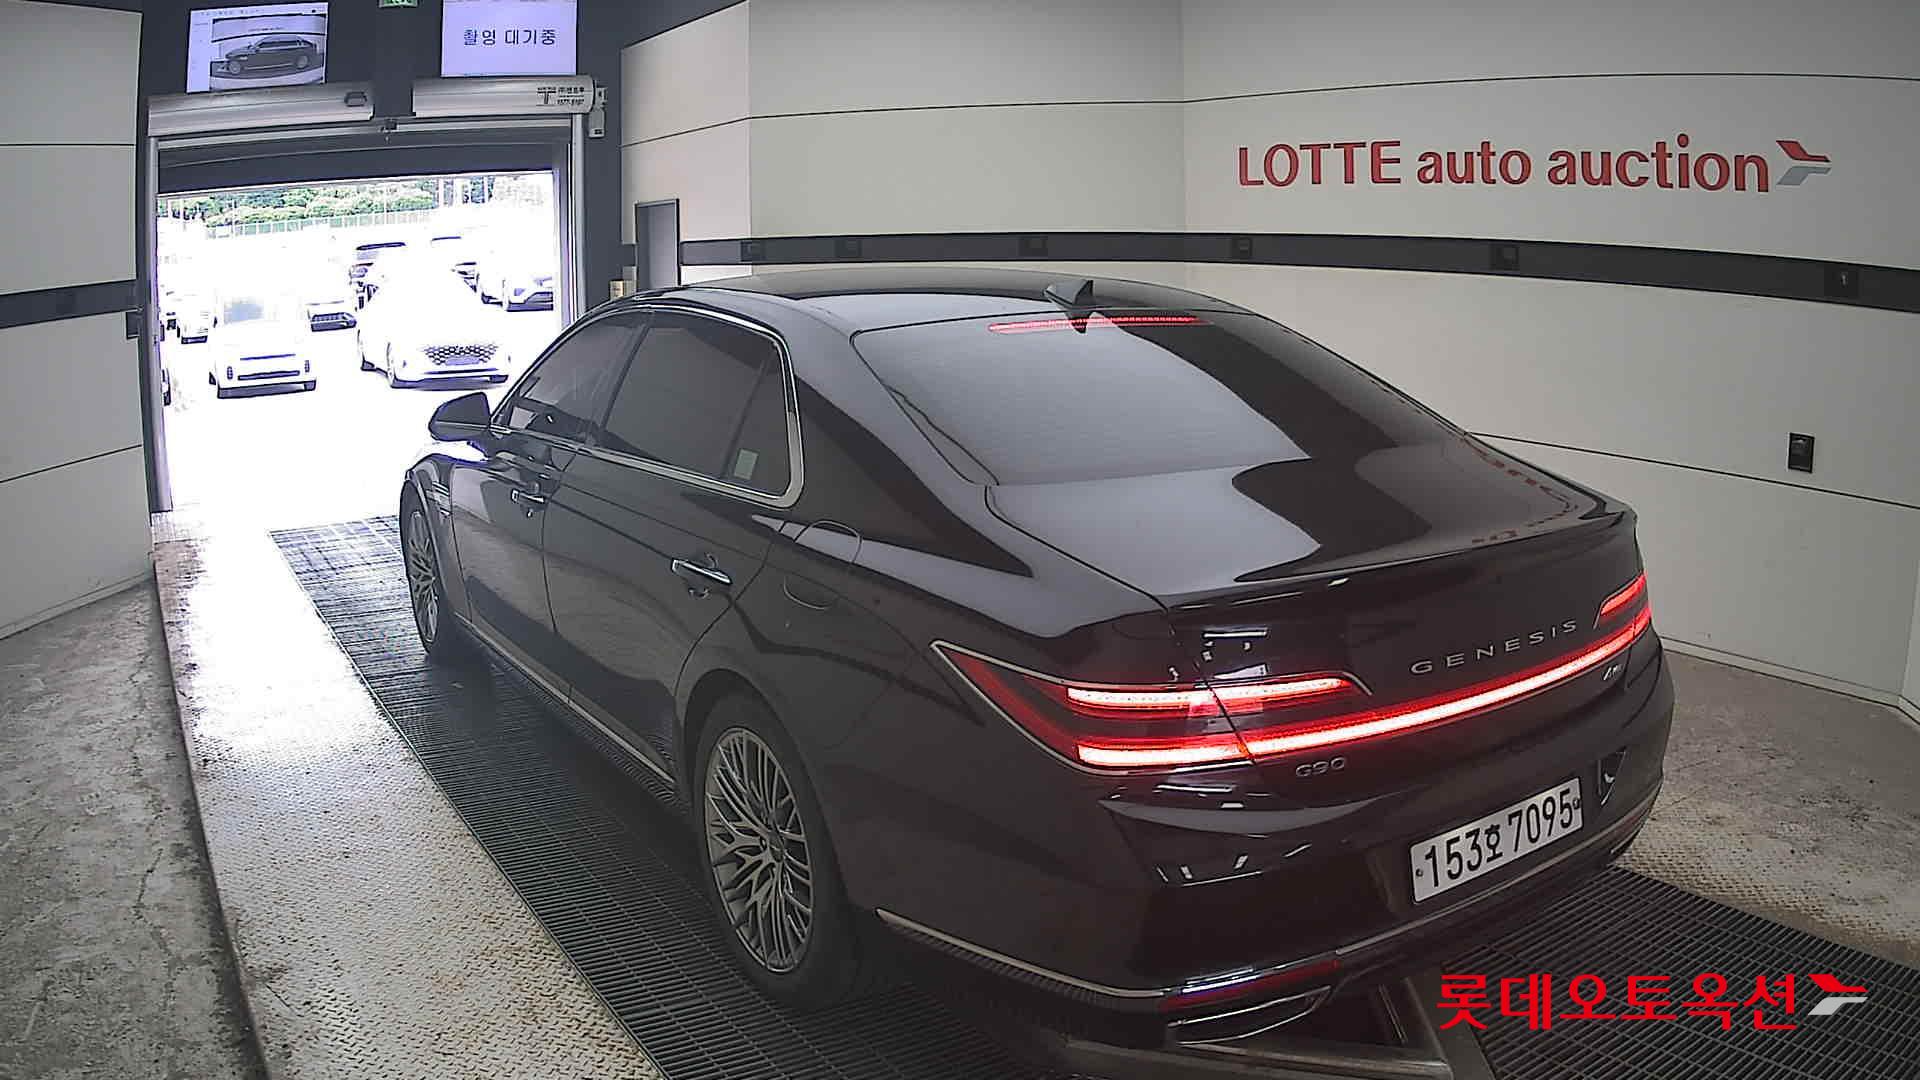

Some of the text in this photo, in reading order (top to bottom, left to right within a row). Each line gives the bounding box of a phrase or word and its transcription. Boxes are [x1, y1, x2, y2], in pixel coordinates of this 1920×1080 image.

[464, 29, 556, 46] 촬영 대기중
[1238, 133, 1768, 192] LOTTE auto auction
[1410, 619, 1577, 675] GENESIS
[1295, 756, 1346, 777] G90
